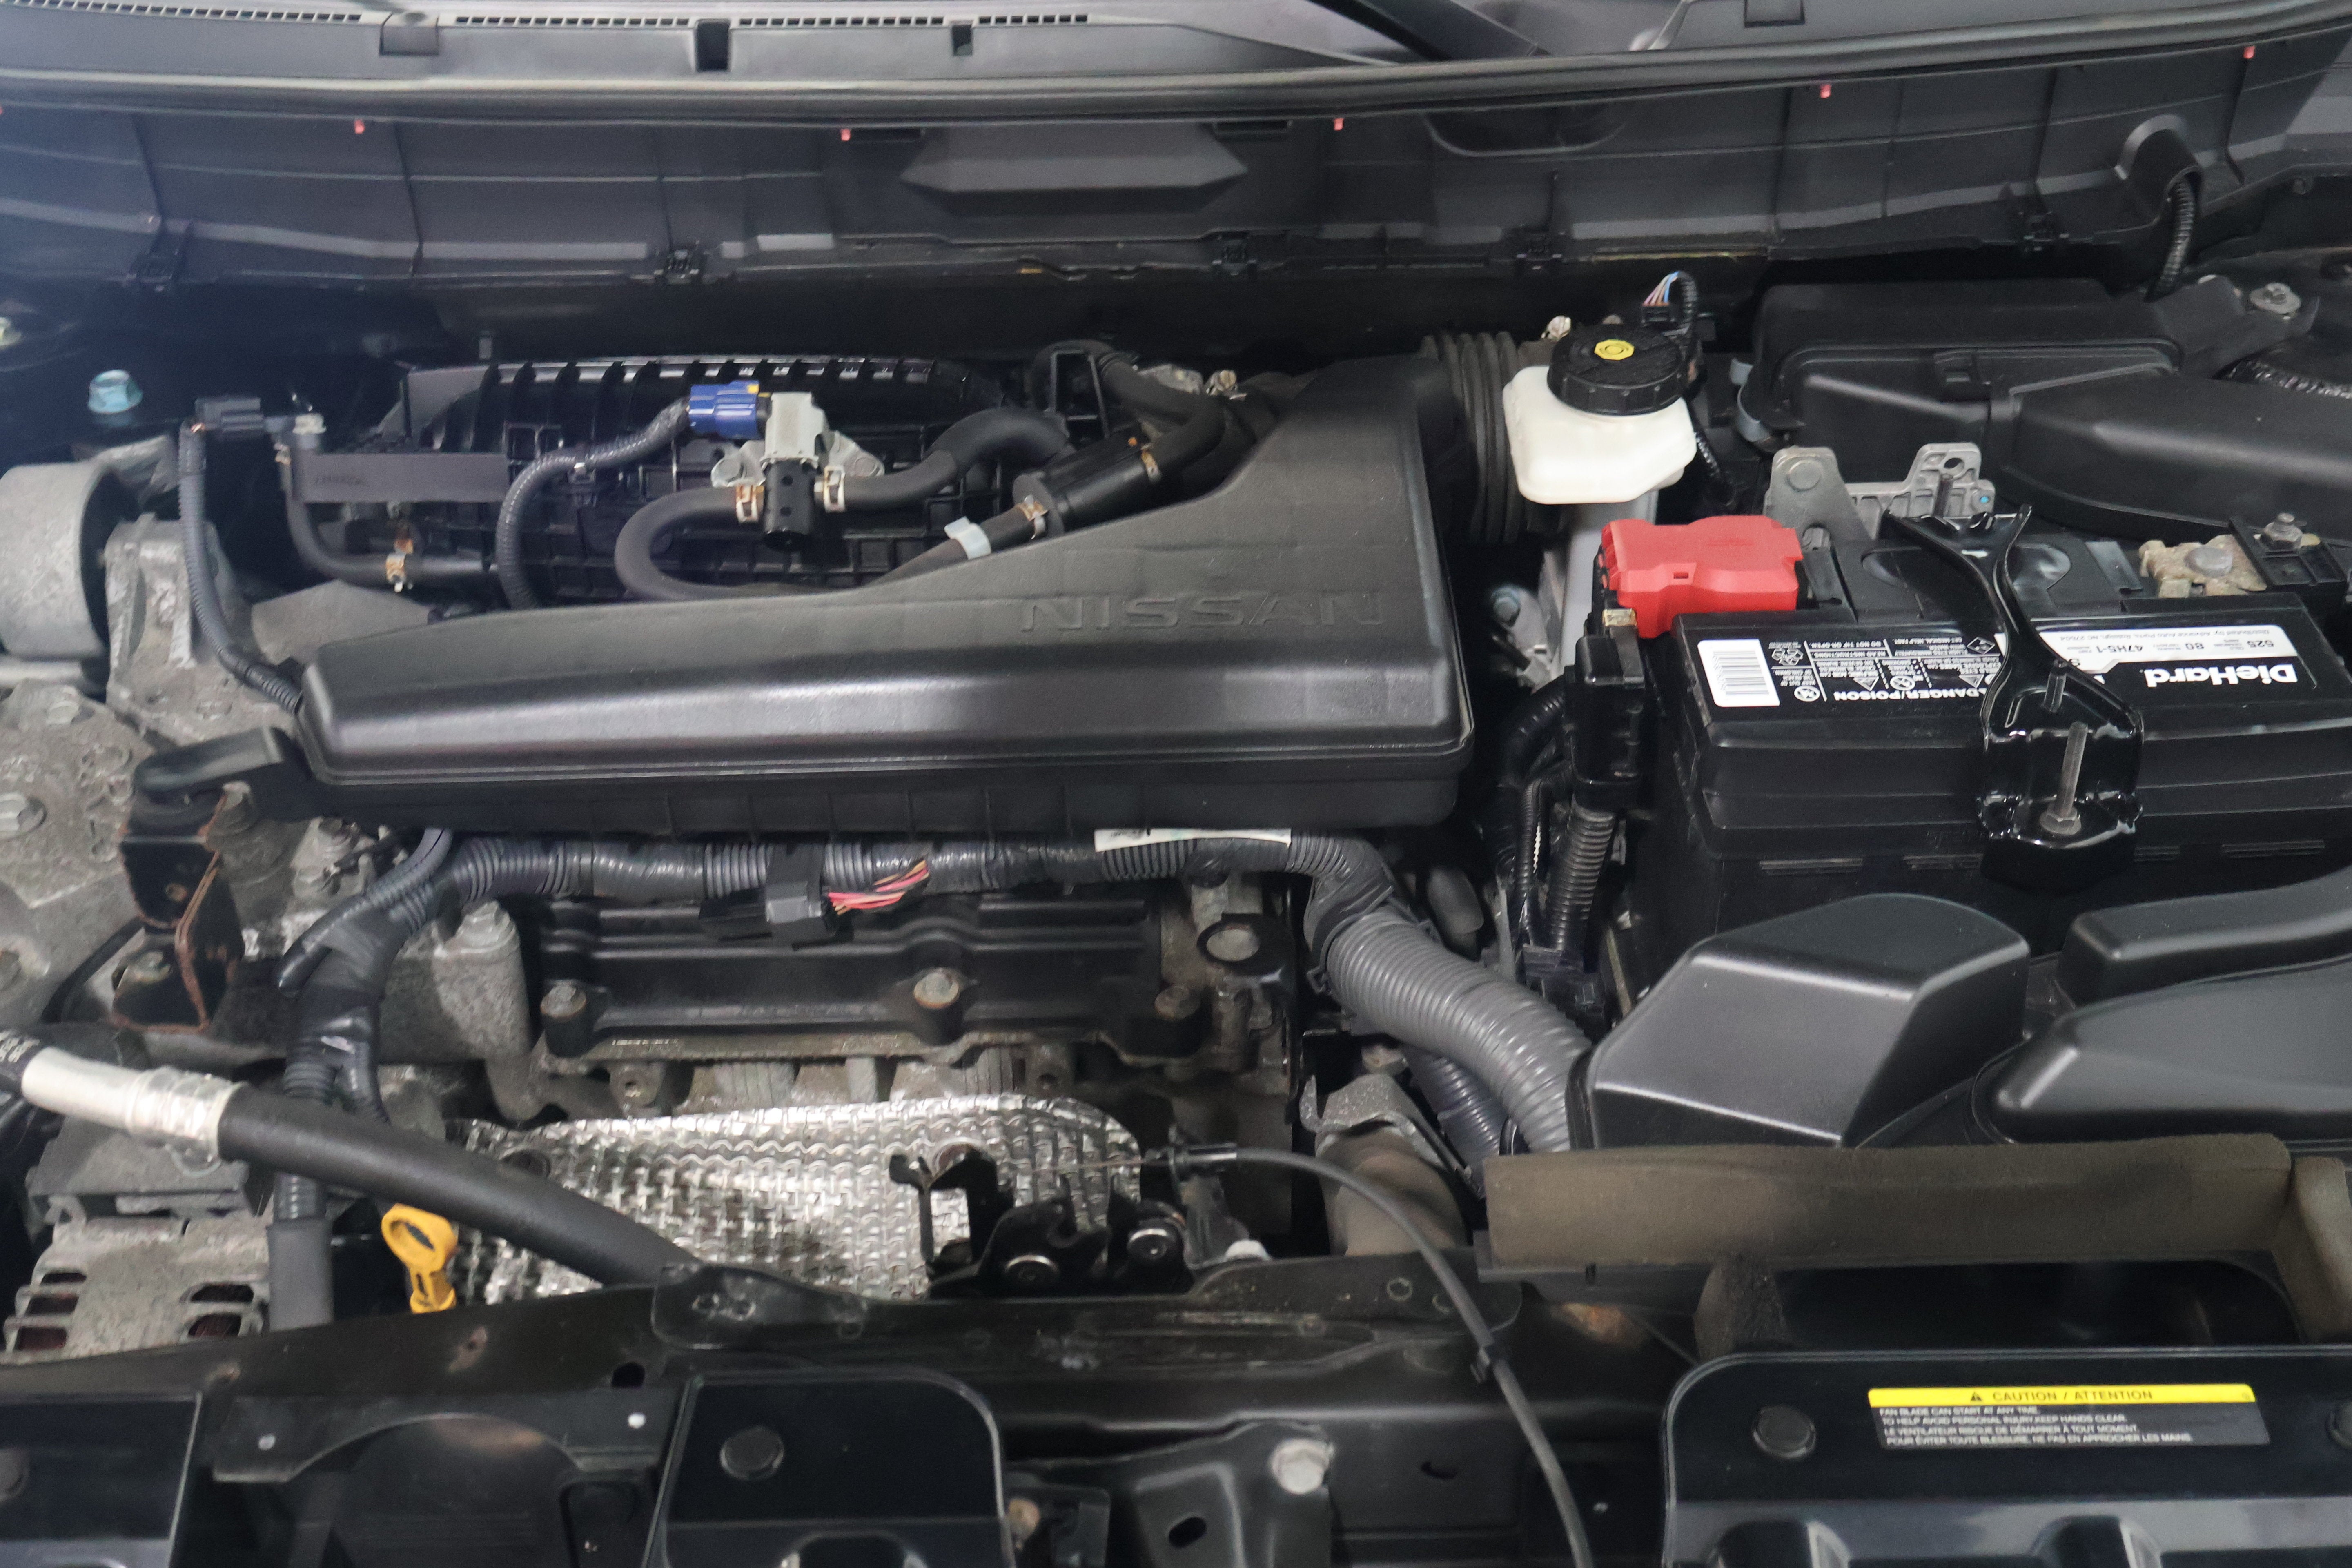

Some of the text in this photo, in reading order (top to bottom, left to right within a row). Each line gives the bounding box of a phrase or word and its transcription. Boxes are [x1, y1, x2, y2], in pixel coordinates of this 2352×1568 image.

[1022, 592, 1384, 632] NISSAN
[2247, 640, 2274, 648] 525
[2145, 664, 2298, 688] DieHard
[1833, 688, 1980, 701] DANGER/POISON
[1992, 1391, 2057, 1401] CAUTION
[2074, 1390, 2153, 1401] ATTENTION
[1880, 1407, 1897, 1416] FAN
[1899, 1407, 1929, 1416] BLADE
[1931, 1407, 1951, 1415] CAN
[1953, 1407, 1980, 1415] START
[1984, 1406, 1993, 1414] AT
[1996, 1406, 2014, 1414] ANY
[1882, 1417, 1895, 1425] TO
[1897, 1417, 1920, 1425] HELP
[1922, 1417, 1950, 1425] AVOID
[1884, 1428, 1897, 1436] LE
[1898, 1427, 1956, 1435] VENTILATEUR
[1995, 1426, 2008, 1434] DE
[2071, 1425, 2094, 1433] TOUT
[1887, 1437, 1914, 1445] POUR
[1949, 1436, 1978, 1445] TOUTE
[2067, 1434, 2081, 1443] EN
[2083, 1434, 2140, 1442] APPROCHER
[2142, 1434, 2160, 1442] LES
